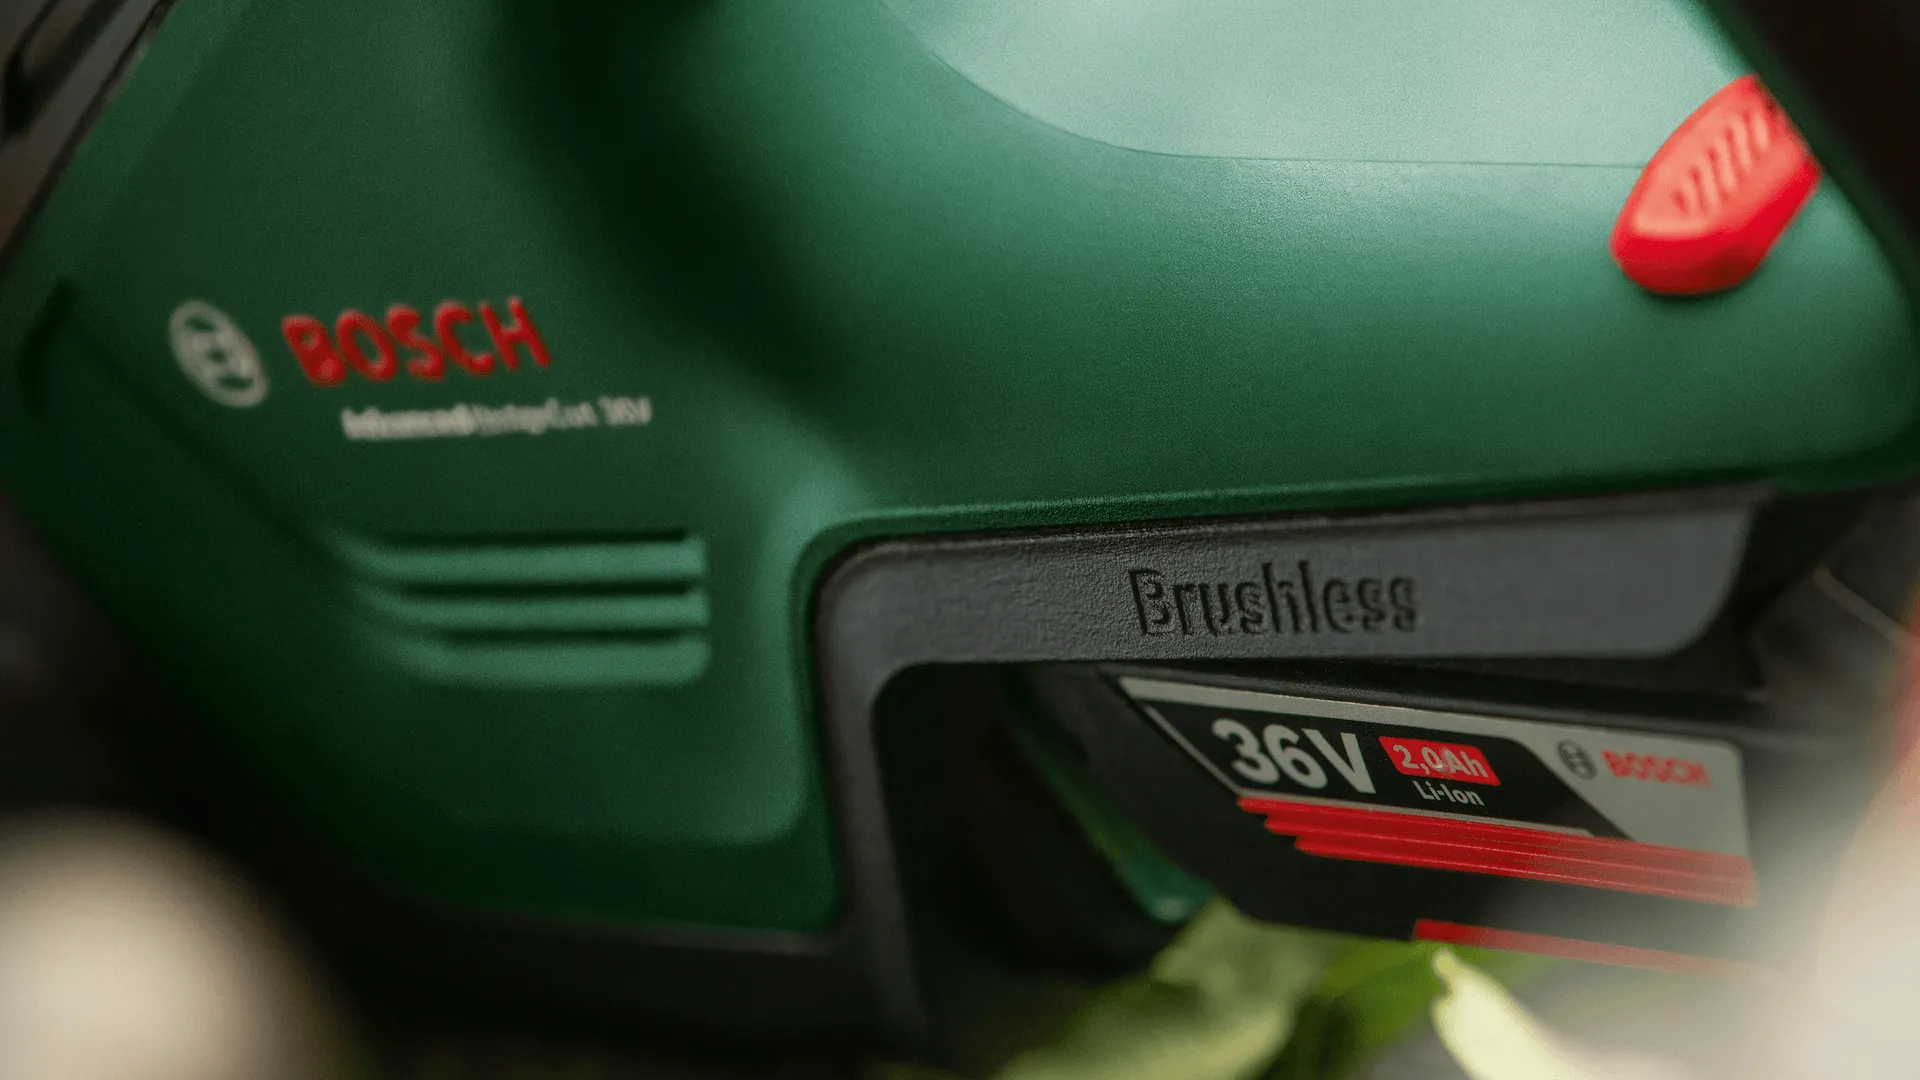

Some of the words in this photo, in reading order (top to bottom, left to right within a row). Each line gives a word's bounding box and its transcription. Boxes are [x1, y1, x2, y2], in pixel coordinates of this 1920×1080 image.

[282, 297, 551, 386] BOSCH
[1128, 560, 1416, 636] Brushless
[1211, 718, 1376, 794] 36V
[1392, 744, 1488, 778] 2,0Ah
[1412, 780, 1485, 806] Li-Ion
